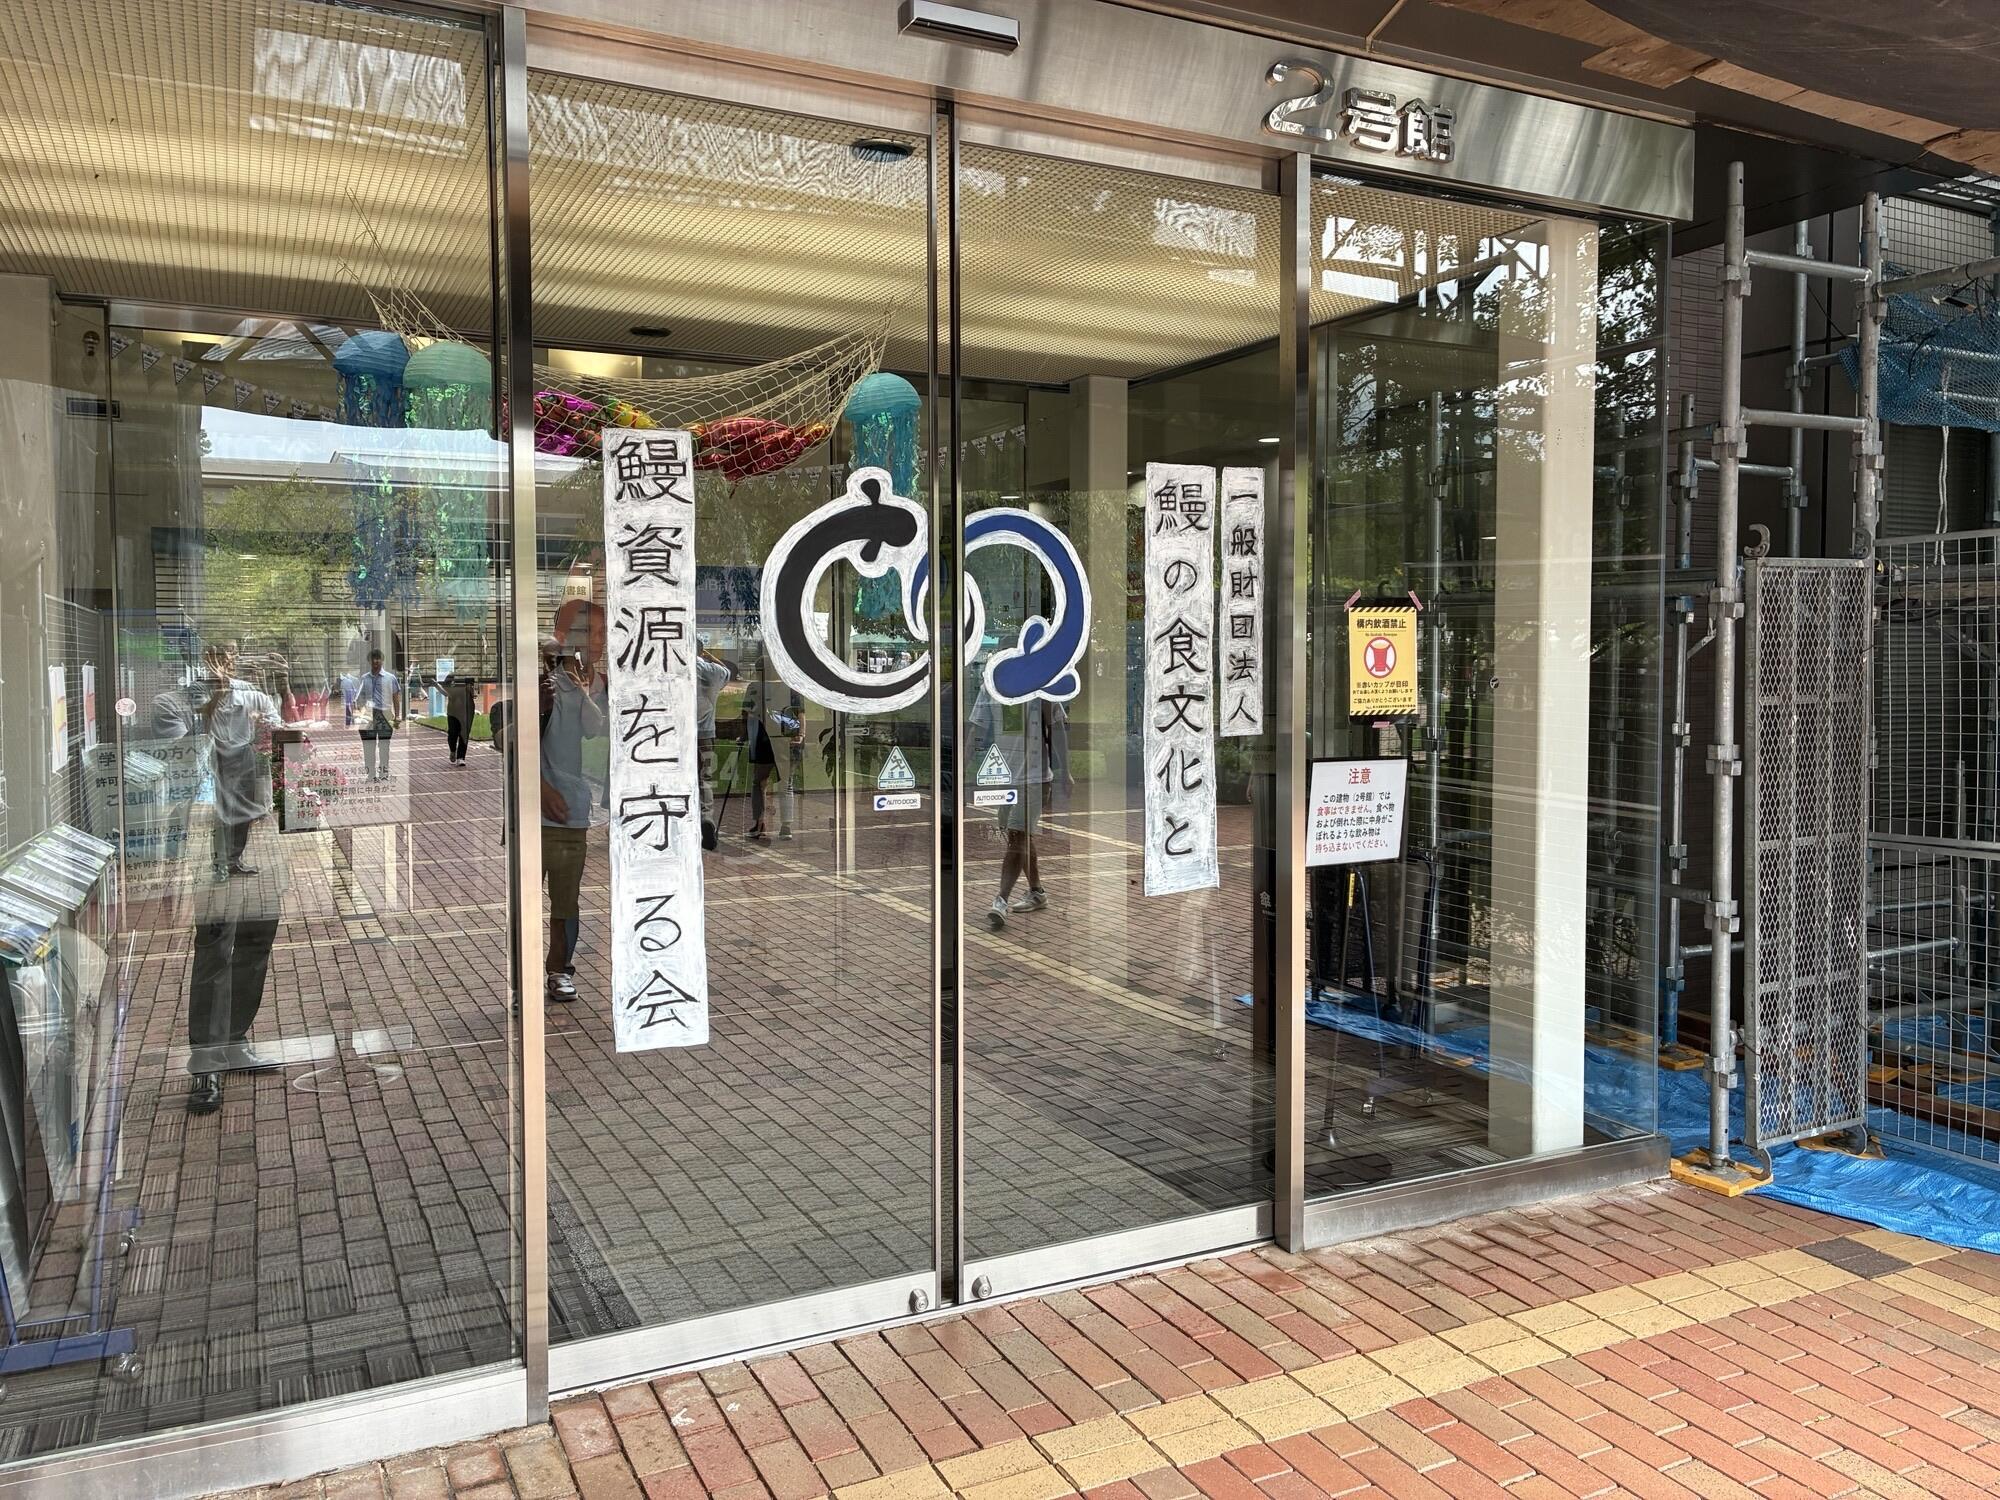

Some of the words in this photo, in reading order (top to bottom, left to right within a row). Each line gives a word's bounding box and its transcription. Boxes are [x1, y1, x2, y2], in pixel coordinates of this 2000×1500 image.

[1261, 58, 1457, 162] 2号館
[1226, 490, 1259, 725] 一般財団法人
[1356, 618, 1407, 629] 構内飲酒禁止
[1154, 483, 1208, 855] 鰻の食文化と
[611, 437, 700, 1030] 鰻資源を守る会
[1348, 768, 1371, 784] 注意
[1317, 803, 1395, 816] 食事はできません。食べ物
[1316, 815, 1393, 829] および倒れた際に中身がこ
[1315, 839, 1389, 854] 持ち込まないでください。
[1259, 890, 1272, 908] 傘
